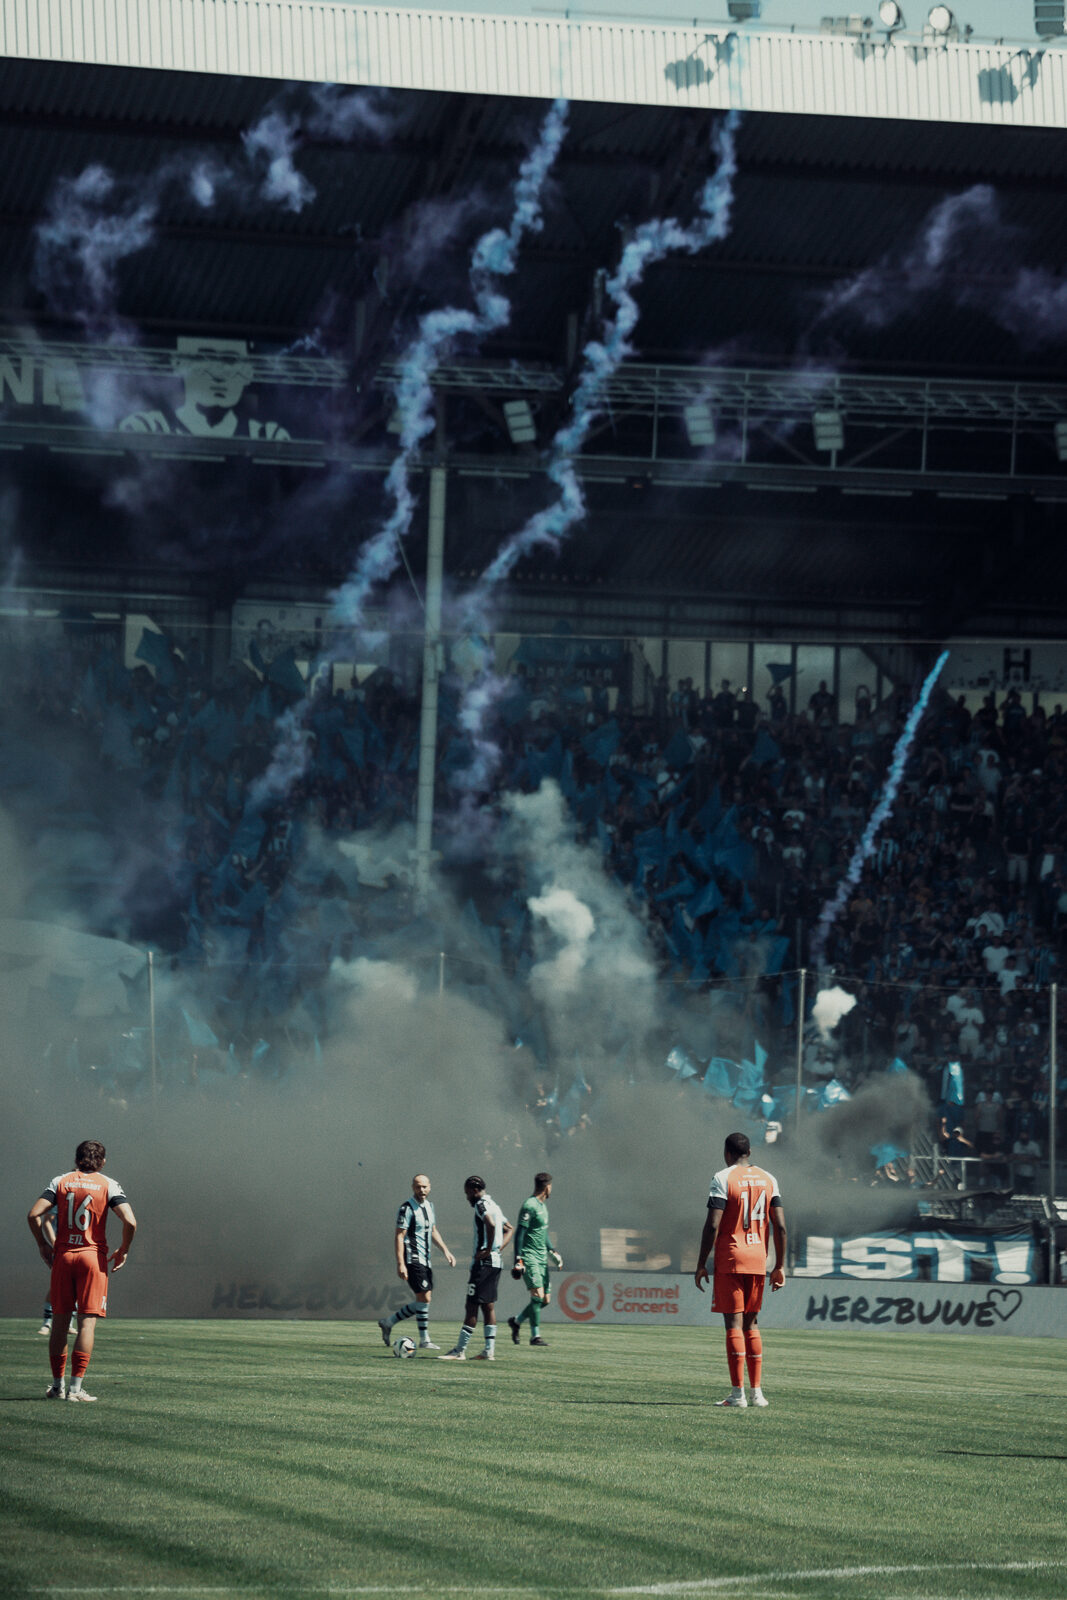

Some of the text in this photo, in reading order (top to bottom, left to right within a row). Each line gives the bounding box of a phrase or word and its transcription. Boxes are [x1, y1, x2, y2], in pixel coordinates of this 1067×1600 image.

[66, 1192, 93, 1231] 16
[741, 1190, 766, 1228] 14
[612, 1284, 680, 1300] Semmel
[612, 1299, 680, 1314] Concerts
[805, 1294, 996, 1327] HERZBUWE
